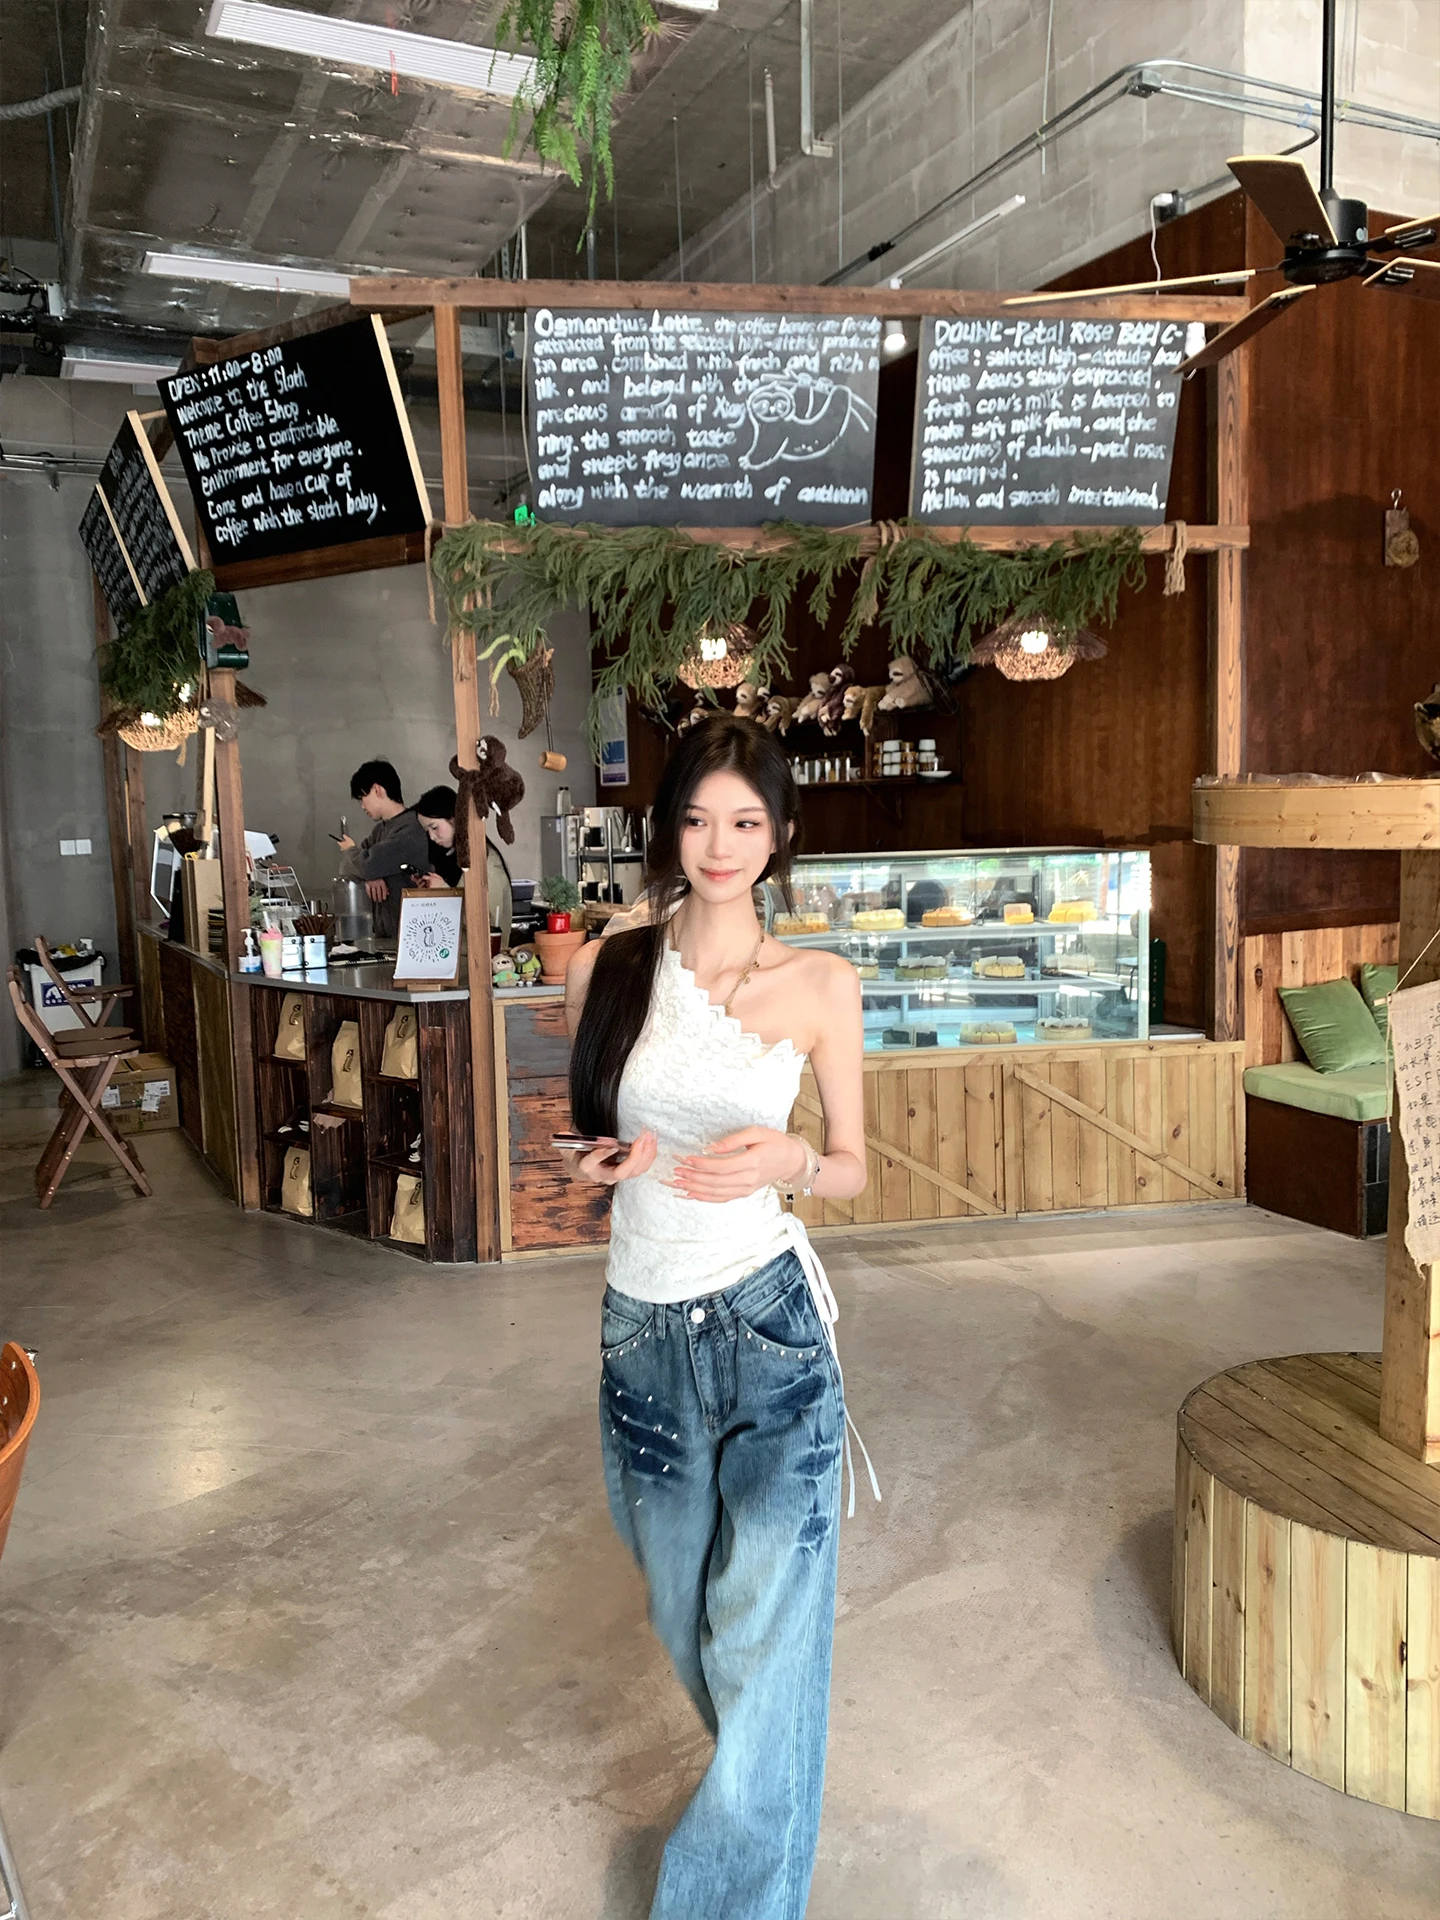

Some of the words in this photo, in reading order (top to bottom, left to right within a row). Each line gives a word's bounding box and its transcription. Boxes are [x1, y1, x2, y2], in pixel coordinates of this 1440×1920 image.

[534, 308, 648, 338] Osmanthus
[1069, 321, 1115, 346] Rose
[611, 332, 649, 356] from
[651, 333, 677, 352] the
[822, 333, 880, 355] product
[985, 345, 1047, 368] selected
[611, 350, 689, 374] combined
[785, 351, 820, 374] and
[829, 351, 864, 374] rich
[176, 394, 226, 427] Welcome
[224, 386, 244, 407] to
[246, 377, 270, 402] the
[273, 361, 308, 396] Sloth
[581, 372, 611, 396] and
[691, 372, 724, 395] with
[732, 374, 761, 396] the
[926, 372, 972, 397] tique
[1026, 366, 1072, 393] slowly
[536, 402, 609, 433] precious
[620, 402, 679, 423] aroma
[687, 394, 708, 425] of
[922, 392, 973, 423] fresh
[1025, 389, 1064, 413] milk
[1156, 391, 1176, 409] to
[1010, 411, 1042, 435] milk
[1092, 406, 1127, 437] and
[1127, 410, 1158, 433] the
[182, 421, 225, 450] Theme
[224, 405, 265, 437] Coffee
[580, 428, 610, 451] the
[685, 427, 738, 450] taste
[192, 450, 211, 473] We
[255, 434, 267, 450] a
[1006, 433, 1027, 463] of
[200, 455, 271, 498] environment
[270, 449, 295, 475] for
[537, 457, 571, 481] and
[581, 450, 639, 476] sweet
[923, 468, 941, 489] is
[241, 484, 265, 510] and
[268, 479, 295, 501] have
[295, 480, 305, 495] a
[335, 461, 353, 492] of
[538, 483, 585, 511] along
[590, 474, 629, 500] with
[633, 475, 671, 500] the
[680, 473, 754, 501] warmth
[763, 475, 792, 506] of
[975, 484, 1005, 511] and
[214, 516, 250, 548] coffee
[252, 505, 283, 532] with
[281, 501, 304, 527] the
[306, 494, 343, 522] sloth
